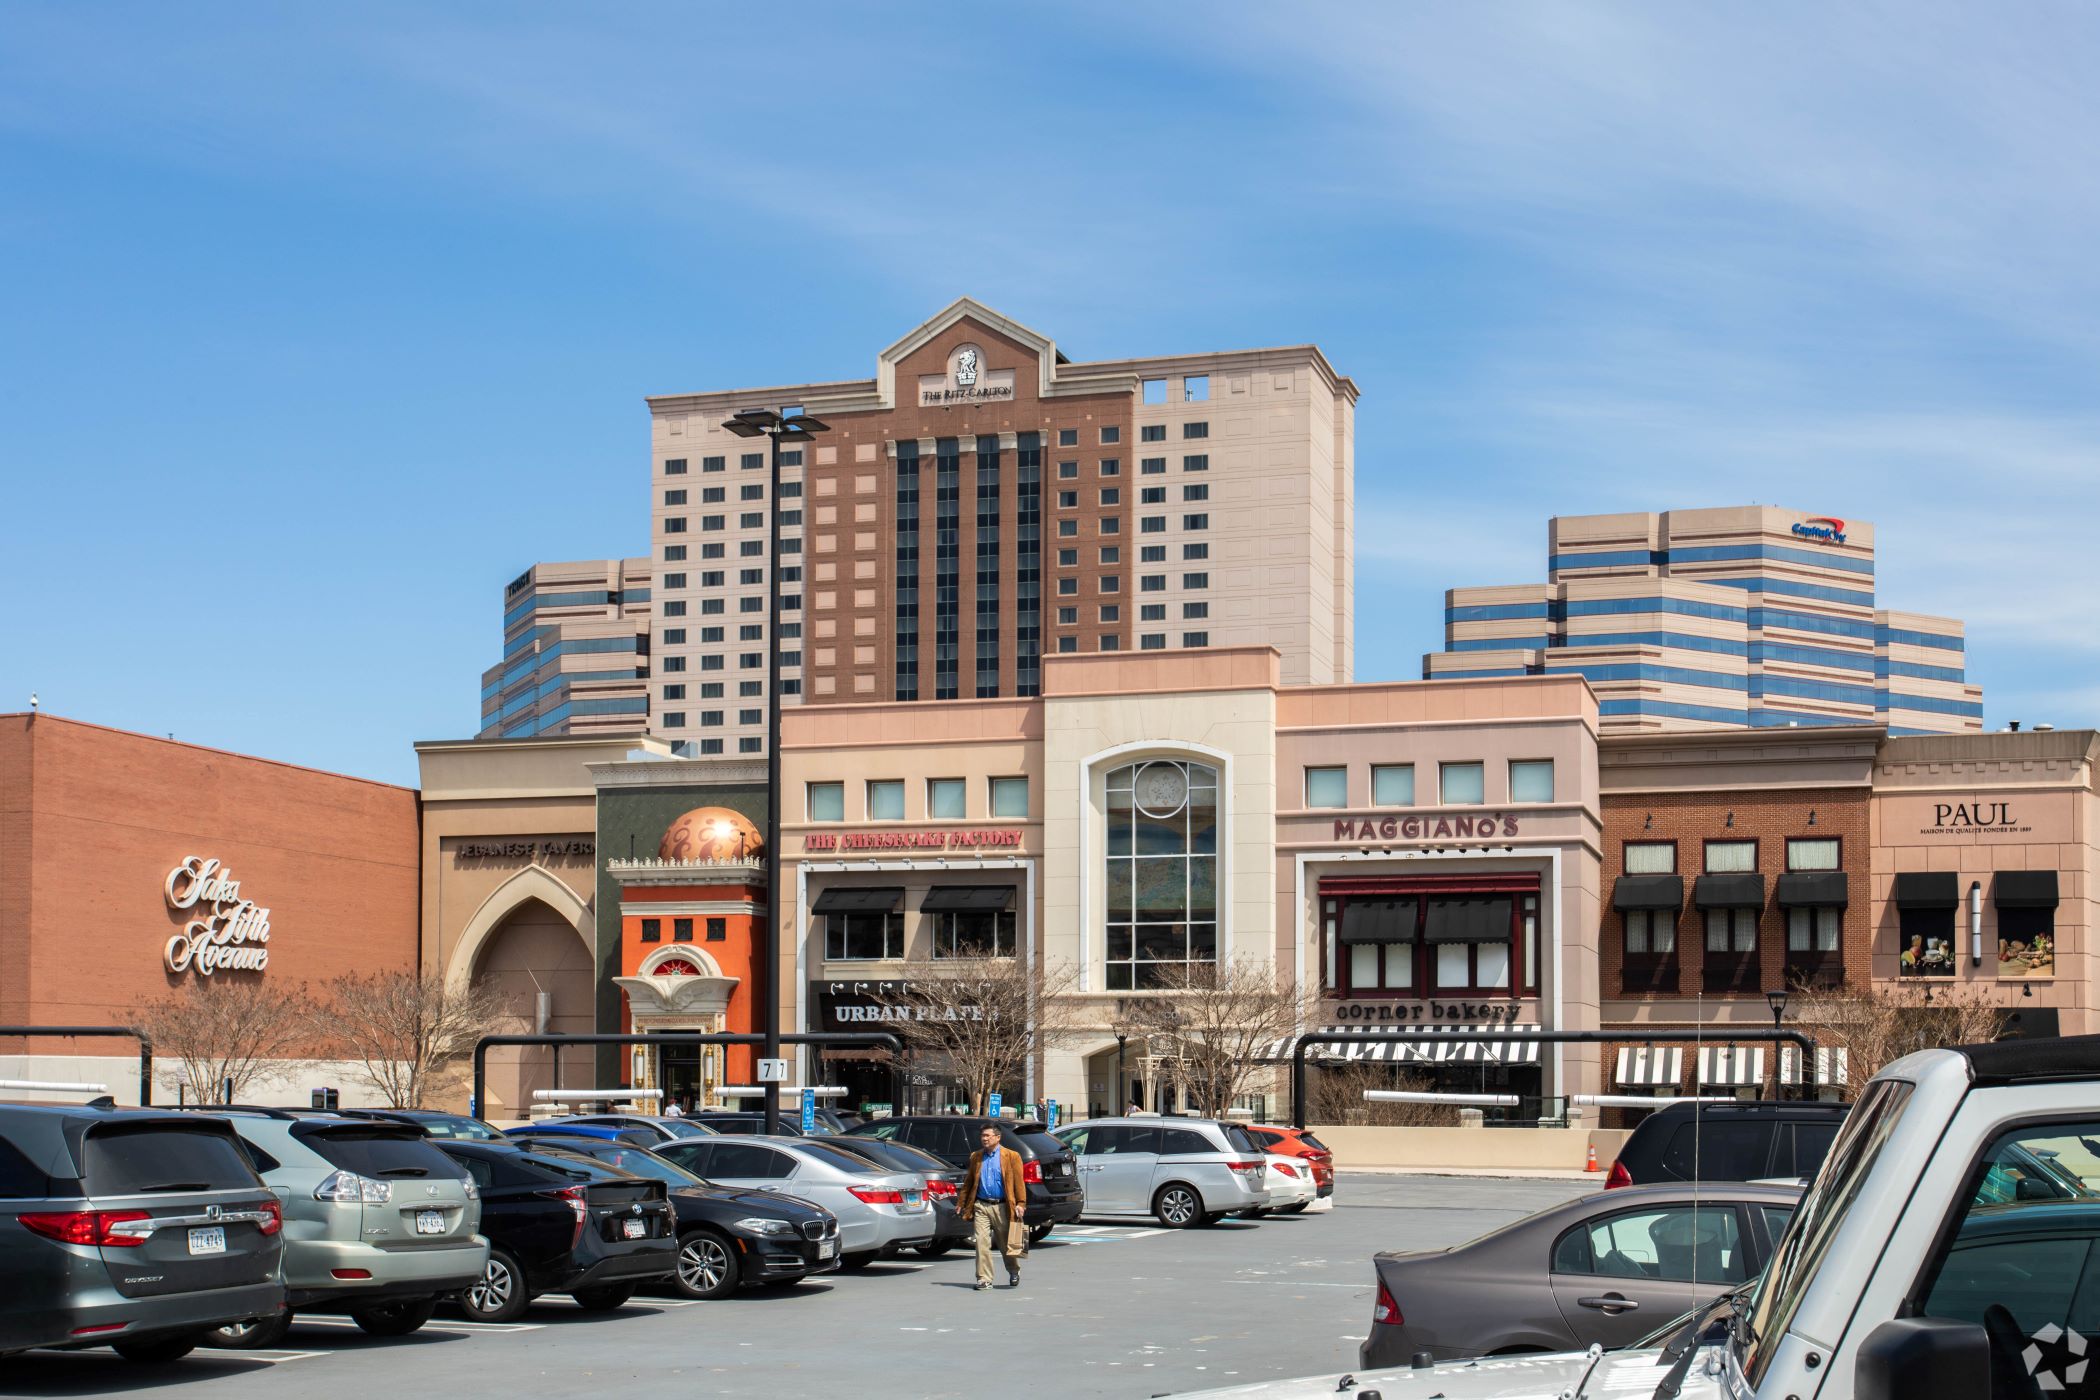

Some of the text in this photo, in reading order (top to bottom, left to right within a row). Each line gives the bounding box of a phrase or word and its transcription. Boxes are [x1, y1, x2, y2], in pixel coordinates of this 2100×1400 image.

[923, 387, 1012, 400] THE RITZ-CARLTON
[1933, 803, 2018, 826] PAUL
[1334, 813, 1519, 841] MAGGIANO'S
[805, 830, 1024, 849] THE CHEESECAKE FACTORY
[458, 842, 535, 858] LEBANESE
[164, 855, 240, 908] Saks
[206, 900, 270, 944] Fifth
[164, 920, 269, 976] Avenue
[835, 1006, 912, 1022] URBAN
[1336, 1001, 1522, 1023] corner bakery
[763, 1063, 771, 1078] 7
[780, 1063, 785, 1078] 7
